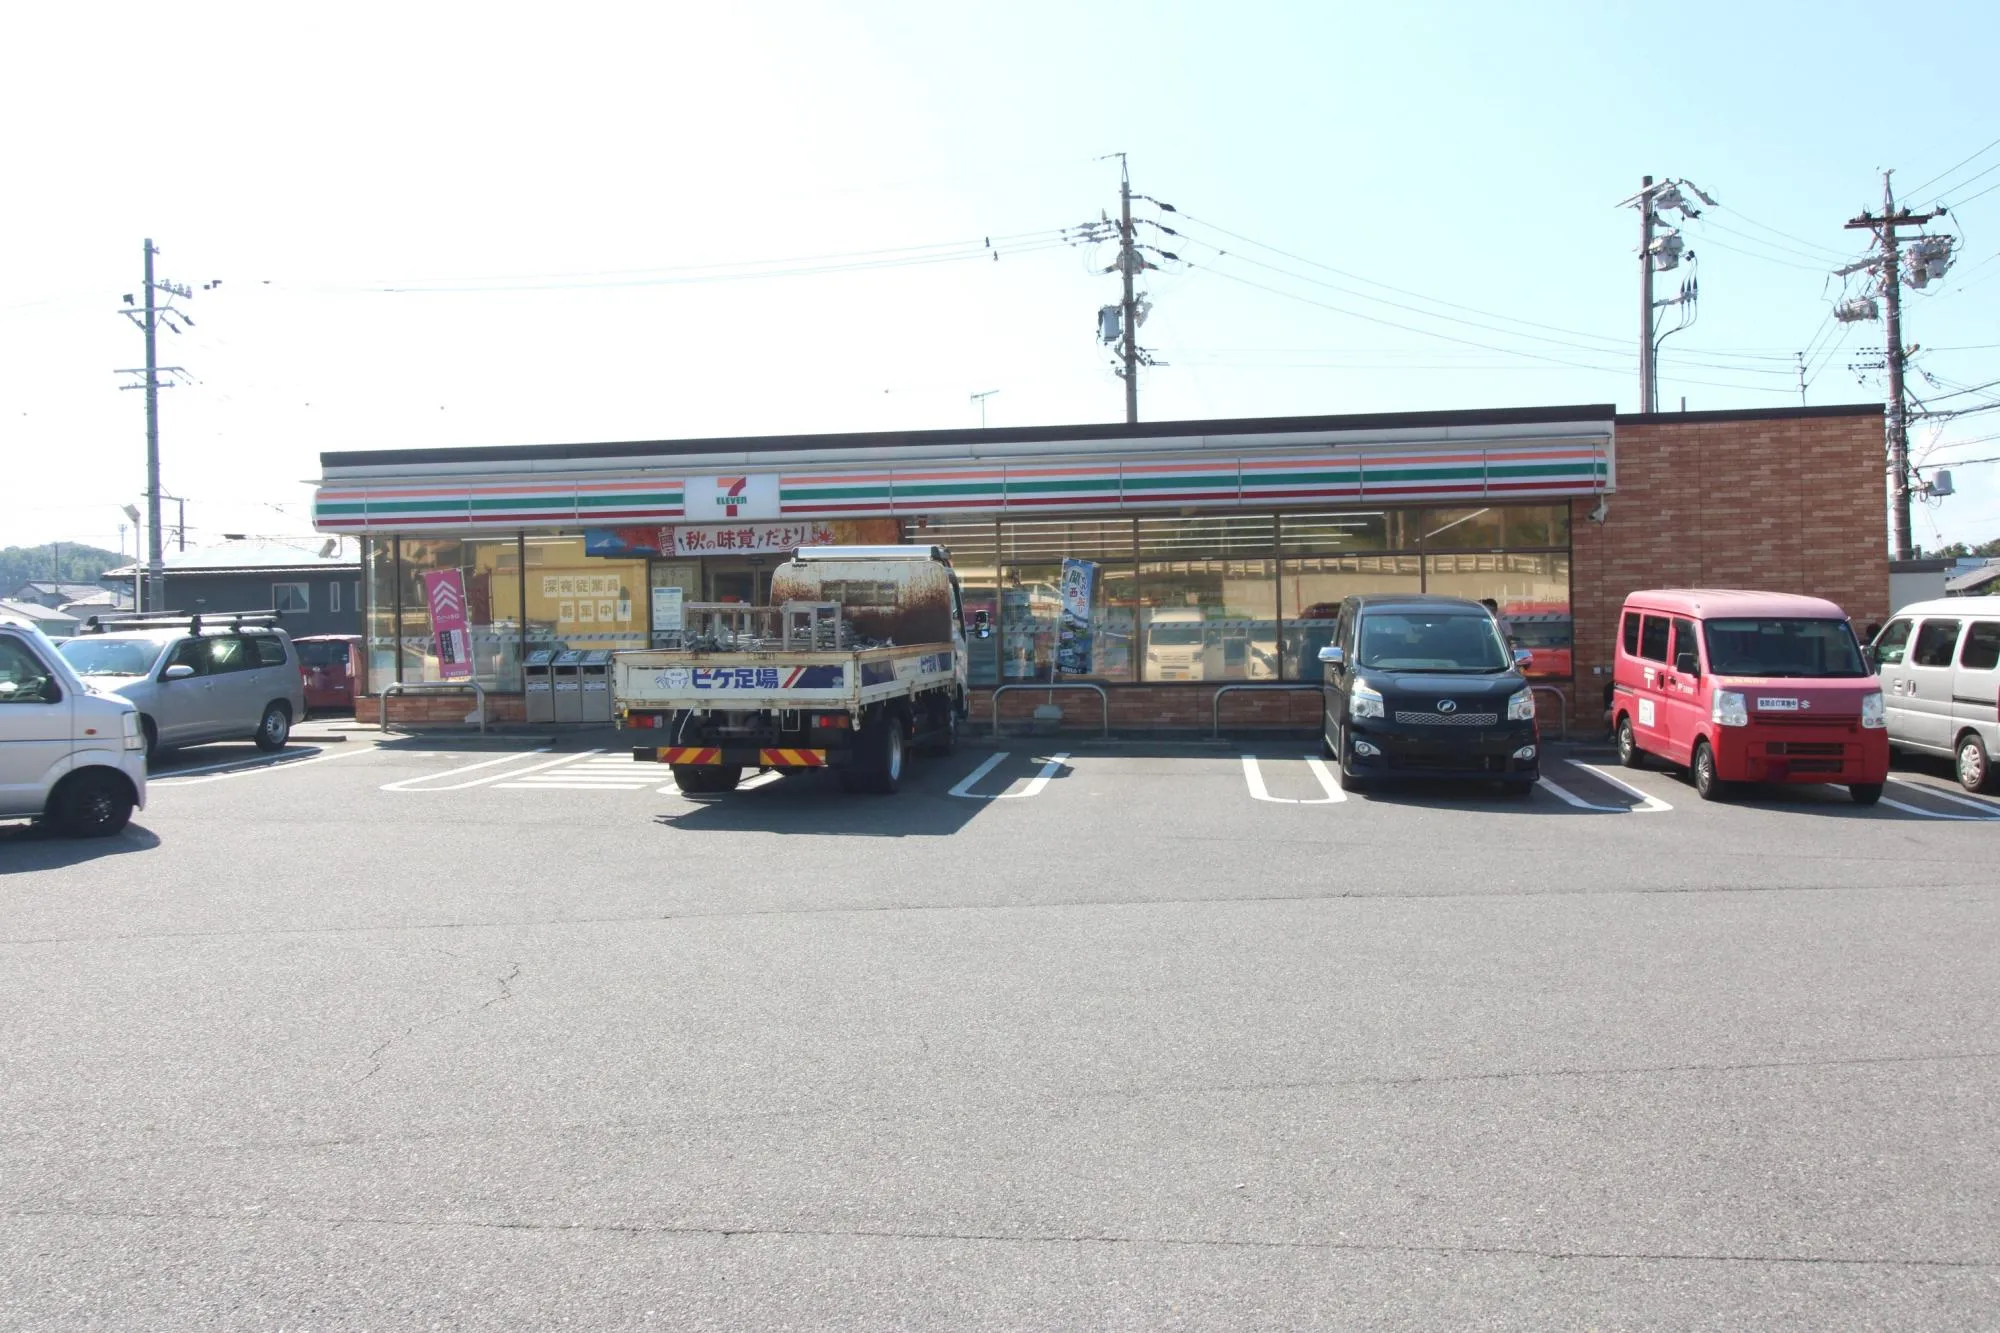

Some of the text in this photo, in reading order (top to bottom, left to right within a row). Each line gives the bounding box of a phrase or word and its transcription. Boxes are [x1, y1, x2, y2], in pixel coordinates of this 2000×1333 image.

[716, 475, 747, 517] 7
[691, 666, 779, 689] ビケ足場
